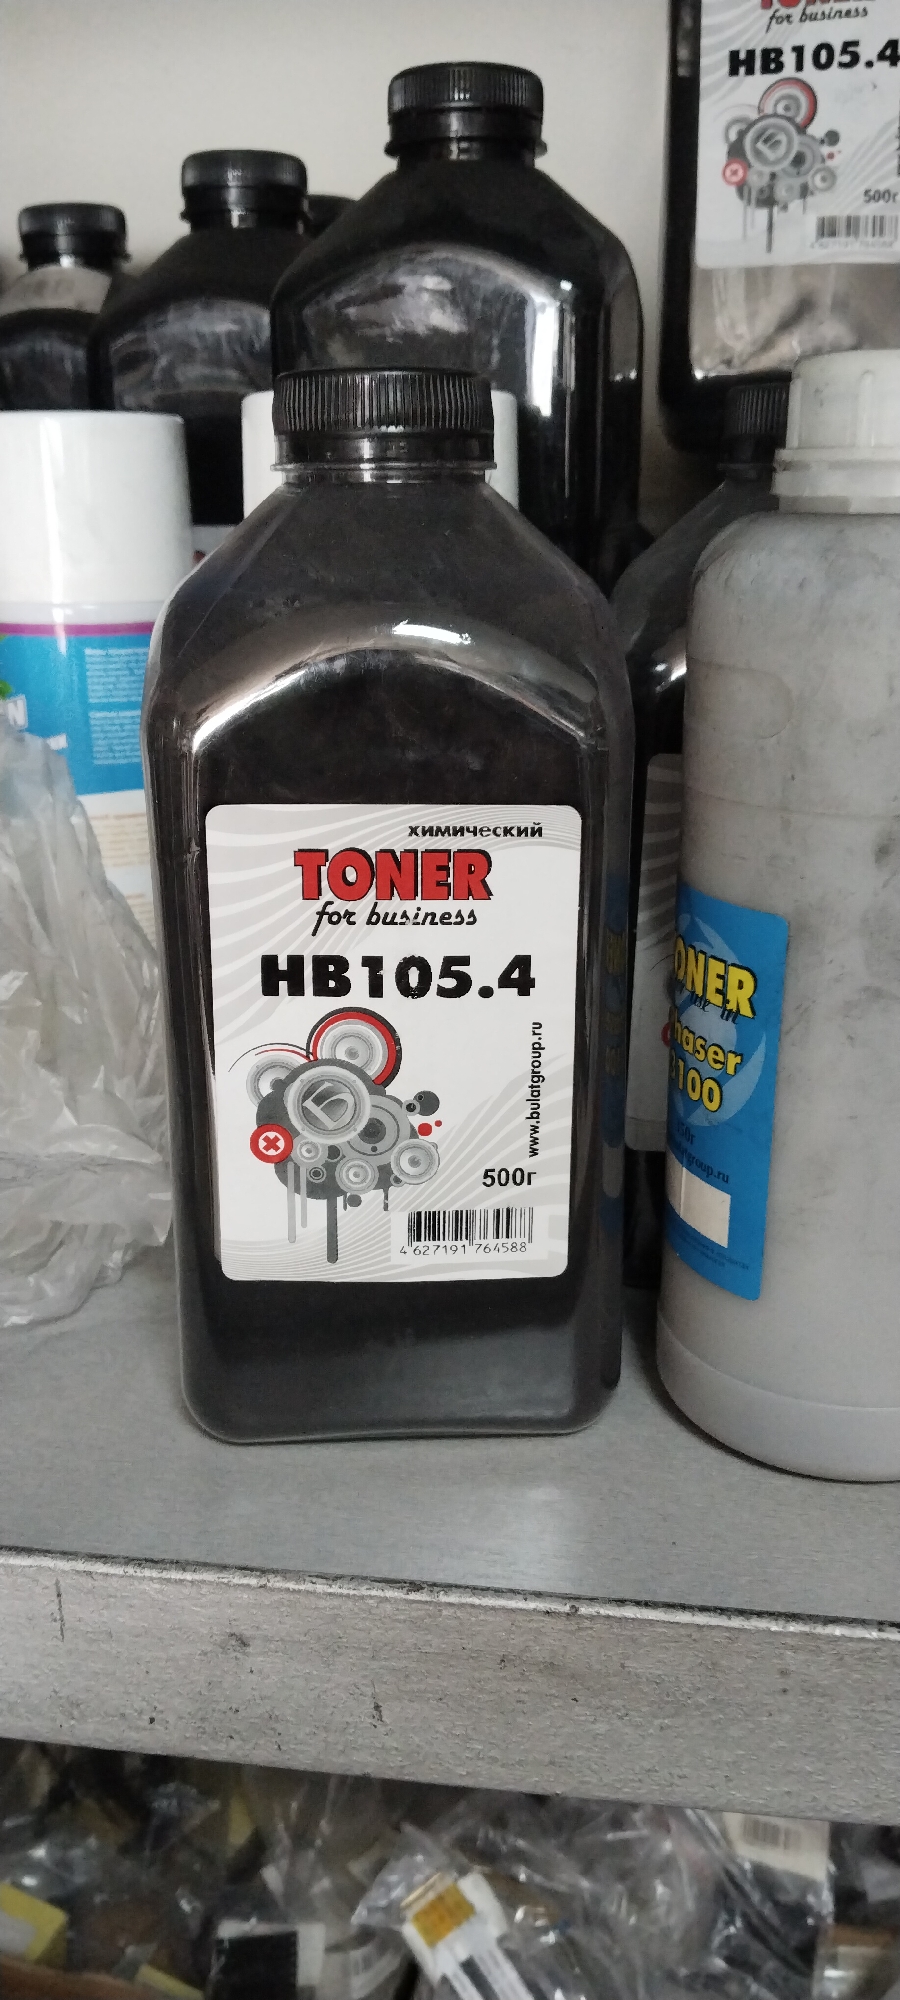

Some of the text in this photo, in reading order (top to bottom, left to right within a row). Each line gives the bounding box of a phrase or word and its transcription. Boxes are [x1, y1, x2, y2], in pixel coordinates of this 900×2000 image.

[766, 8, 794, 33] for
[799, 4, 869, 23] business
[728, 38, 900, 77] HB105.4
[408, 822, 543, 839] химический
[293, 848, 494, 902] TONER
[312, 900, 478, 937] for business
[260, 954, 537, 999] HB105.4
[673, 935, 758, 1019] ONER
[526, 1021, 545, 1158] www.bulatgroup.ru
[481, 1168, 538, 1187] 500г
[399, 1241, 528, 1256] 4 627191 764588
